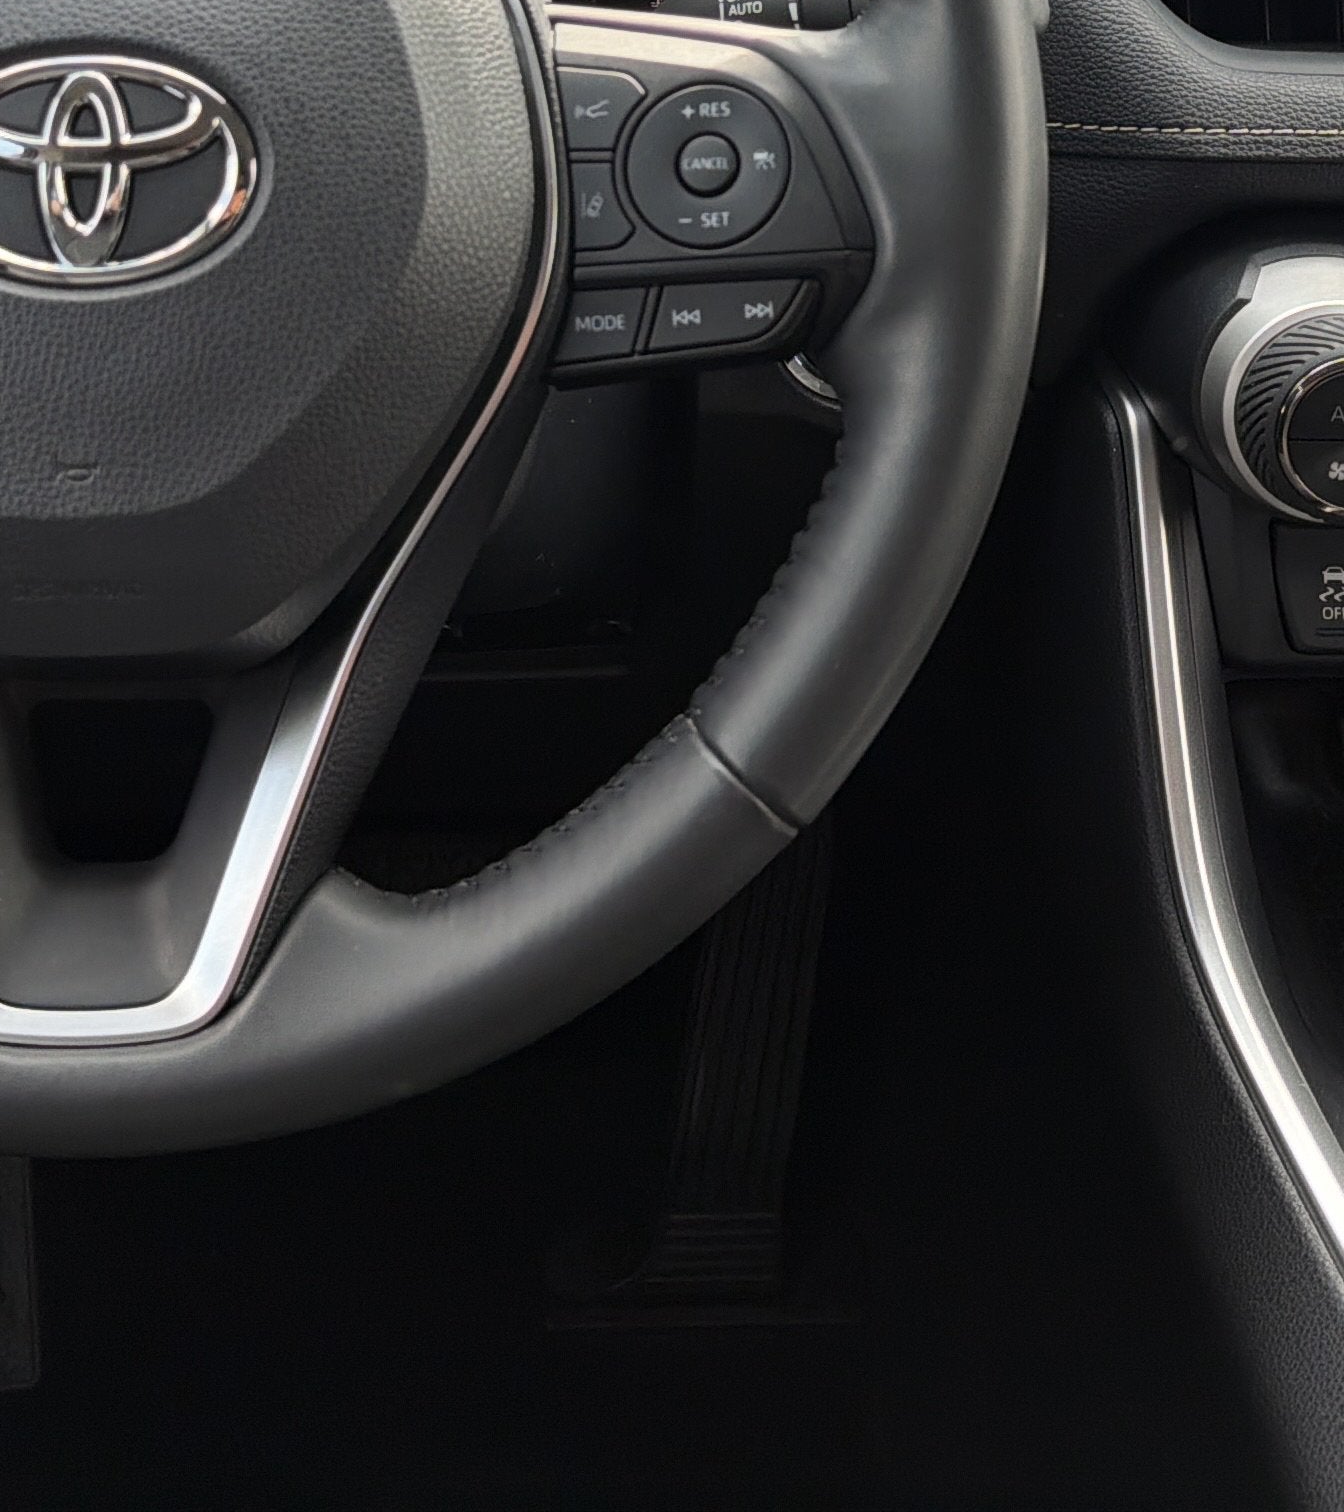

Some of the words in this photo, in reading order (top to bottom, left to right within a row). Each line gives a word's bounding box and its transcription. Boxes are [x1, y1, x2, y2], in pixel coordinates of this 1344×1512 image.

[727, 0, 763, 17] AUTO
[682, 156, 730, 171] CANCEL
[575, 313, 626, 333] MODE
